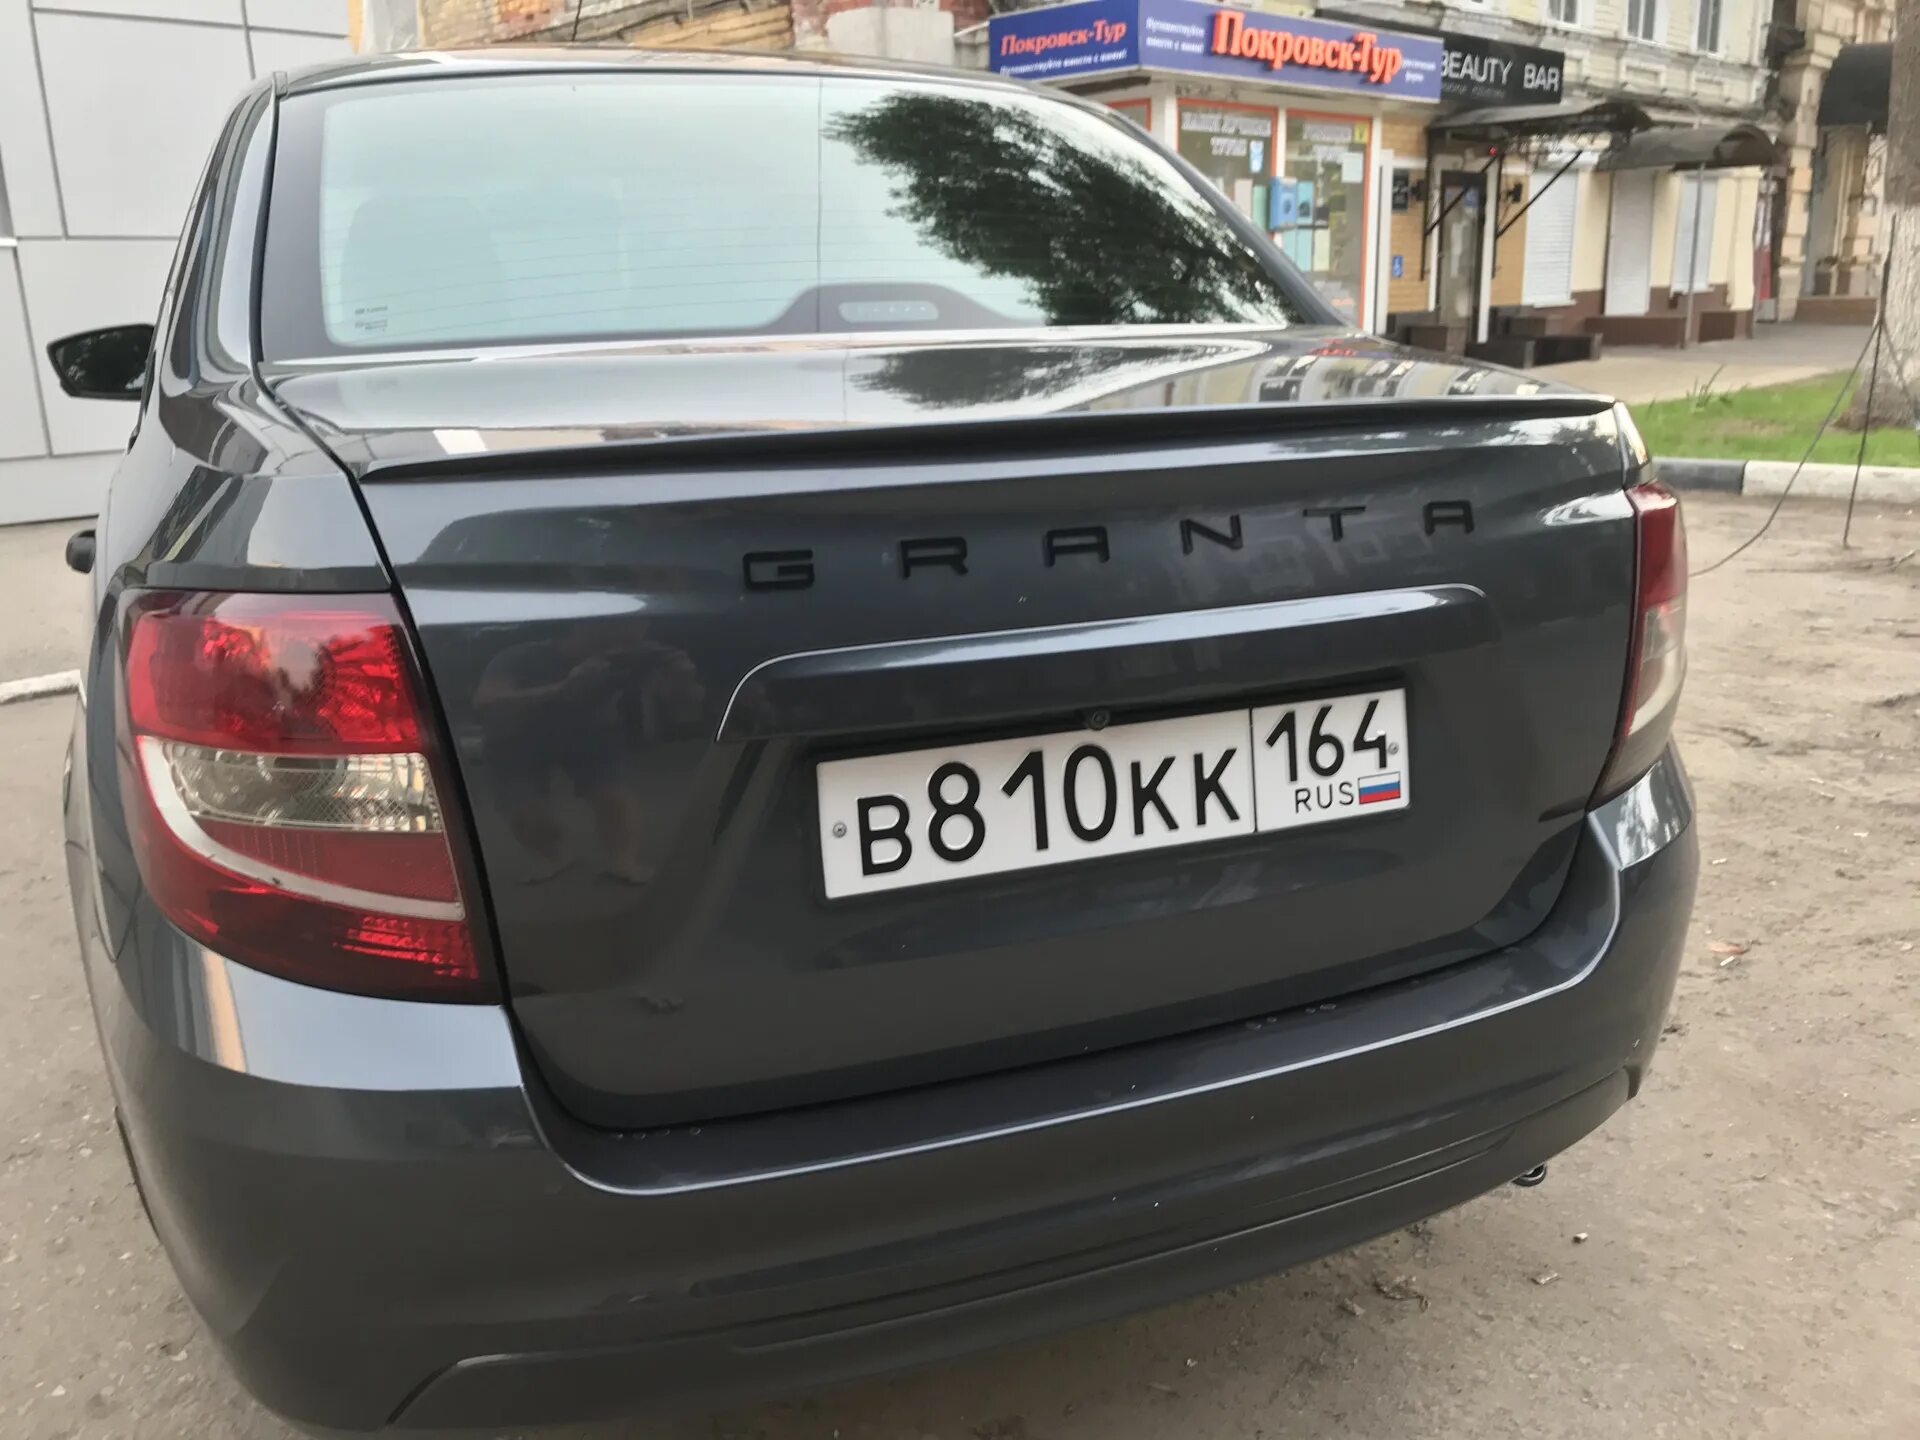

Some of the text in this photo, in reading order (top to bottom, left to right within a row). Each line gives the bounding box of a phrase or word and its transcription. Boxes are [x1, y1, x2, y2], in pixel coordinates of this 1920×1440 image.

[1001, 19, 1127, 56] Покровск-Тур
[1212, 10, 1402, 84] Покровск-Тур
[1523, 62, 1559, 92] BAR
[742, 500, 1475, 590] GRANTA
[1265, 699, 1388, 782] 164
[1294, 782, 1354, 813] RUS
